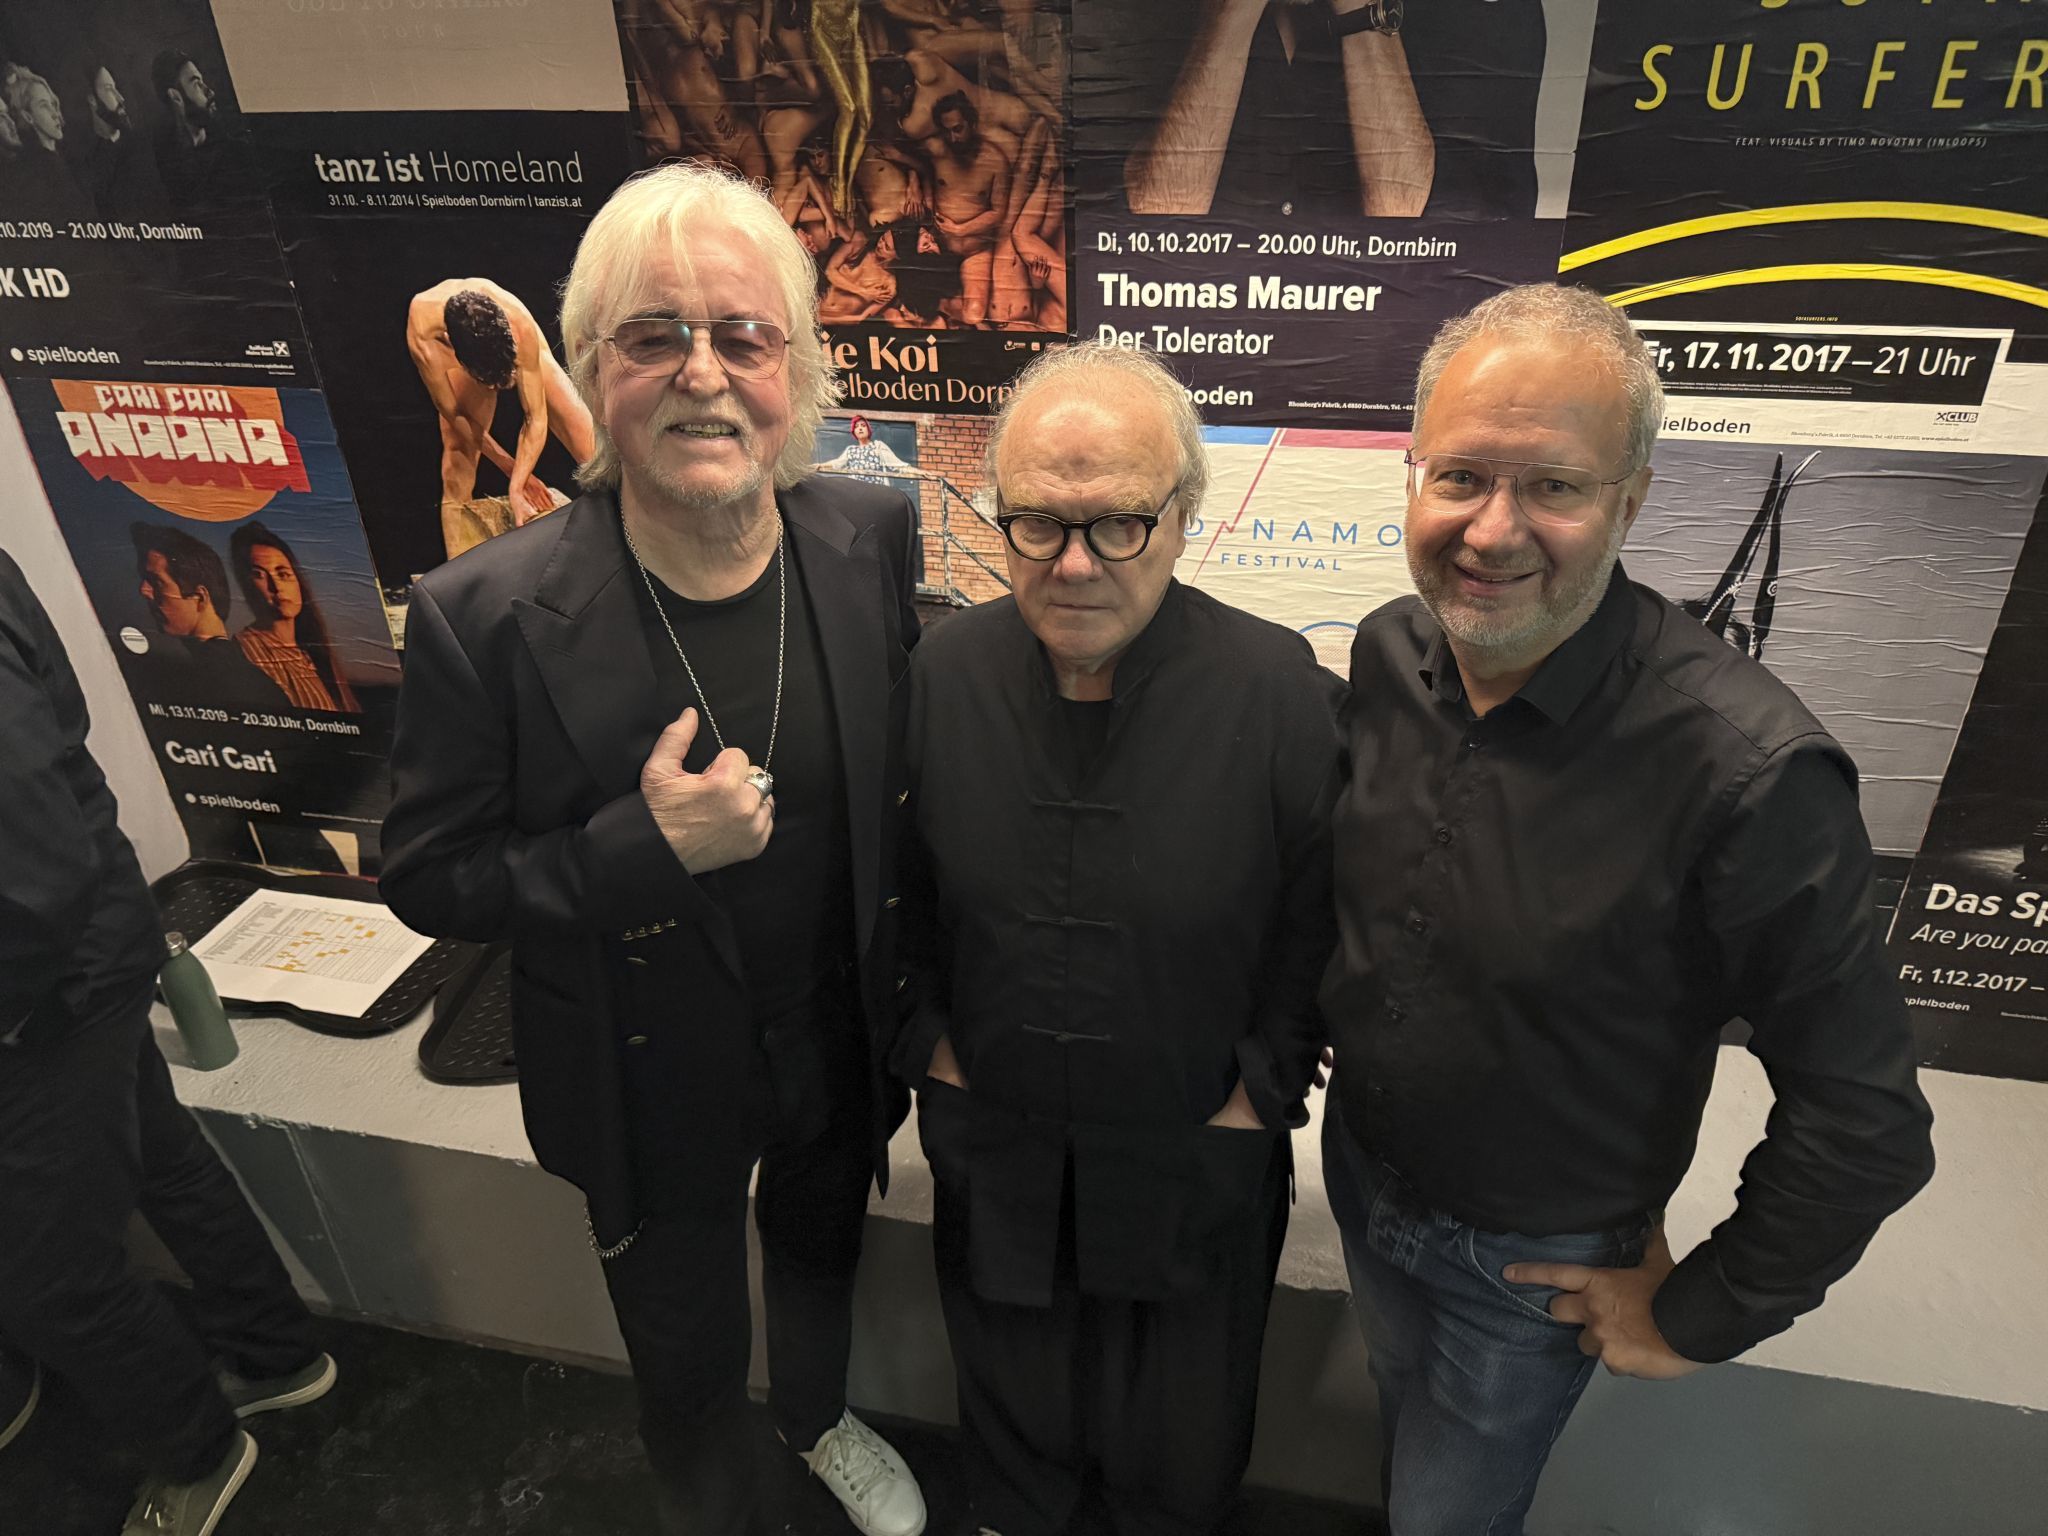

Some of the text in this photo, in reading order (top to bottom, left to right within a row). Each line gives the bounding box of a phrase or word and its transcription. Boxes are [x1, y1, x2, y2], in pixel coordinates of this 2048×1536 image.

[1635, 40, 2048, 111] SURFER
[1769, 137, 1815, 147] VISUALS
[1819, 137, 1833, 147] BY
[1837, 137, 1866, 147] TIMO
[1870, 137, 1923, 147] NOVOTNY
[314, 151, 583, 184] tanz ist Homeland
[328, 194, 358, 207] 31.10.
[367, 194, 415, 208] 8.11.2014
[422, 194, 478, 209] Spielboden
[480, 194, 526, 208] Dornbirn
[534, 195, 583, 209] tanzist.at
[0, 222, 54, 239] .10.2019
[68, 222, 107, 239] 21.00
[110, 223, 140, 242] Uhr,
[141, 223, 204, 241] Dornbirn
[1098, 231, 1124, 254] Di,
[1128, 232, 1233, 254] 10.10.2017
[1257, 234, 1316, 255] 20.00
[1321, 235, 1362, 258] Uhr,
[1367, 235, 1458, 258] Dornbirn
[0, 267, 71, 298] K HD
[1097, 272, 1383, 312] Thomas Maurer
[820, 330, 939, 373] ie Koi
[1098, 324, 1275, 355] Der Tolerator
[28, 346, 121, 365] spielboden
[1918, 347, 1977, 378] Uhr
[93, 384, 233, 414] CARI CARI
[835, 372, 1020, 404] elboden Dorn
[1662, 416, 1751, 434] ielboden
[1220, 553, 1343, 572] FESTIVAL
[148, 703, 169, 718] Mi,
[169, 705, 229, 722] 13.11.2019
[242, 712, 278, 728] 20.30
[278, 716, 305, 731] Uhr,
[305, 718, 361, 736] Dornbirn
[165, 740, 278, 774] Cari Cari
[199, 793, 281, 814] spielboden
[1924, 883, 2003, 917] Das
[1909, 923, 2048, 956] Are you pa
[1899, 964, 1923, 984] Fr,
[1931, 968, 2028, 992] 1.12.2017
